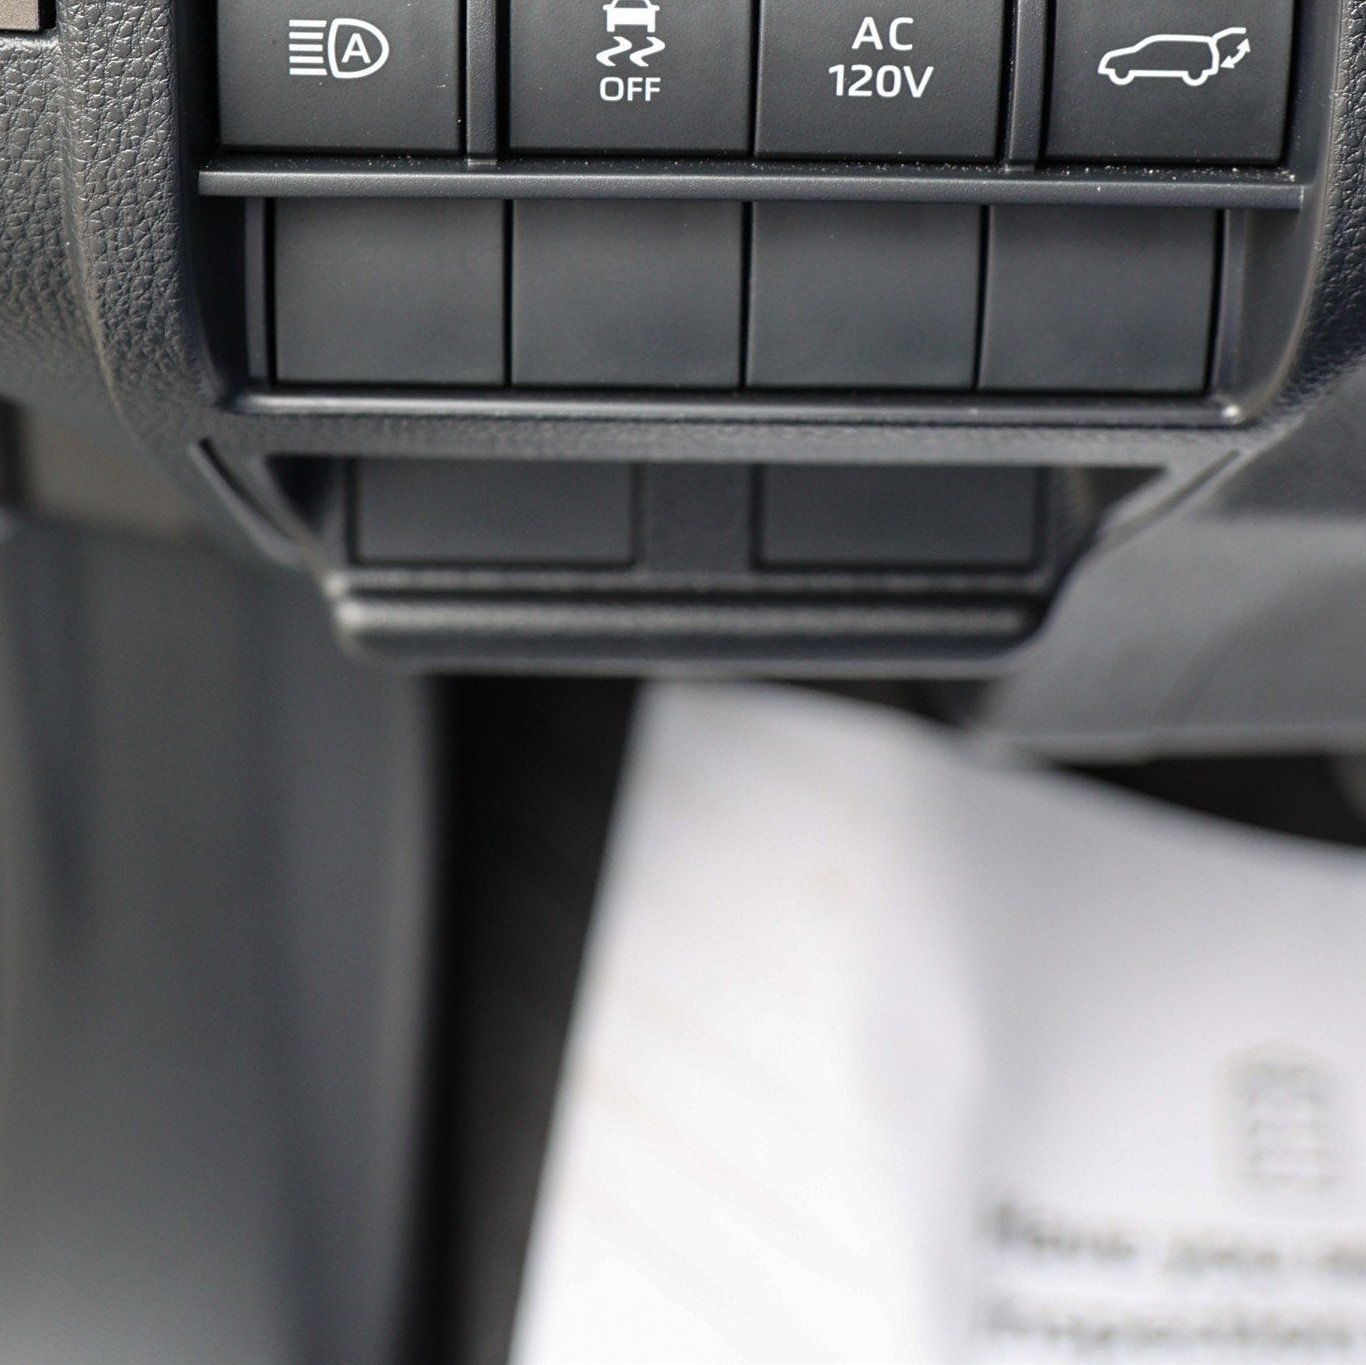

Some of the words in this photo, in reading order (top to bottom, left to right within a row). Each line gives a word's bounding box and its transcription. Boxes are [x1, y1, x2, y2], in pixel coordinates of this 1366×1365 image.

[341, 33, 371, 64] A
[851, 16, 914, 51] AC
[598, 76, 662, 102] OFF
[828, 63, 935, 98] 120V
